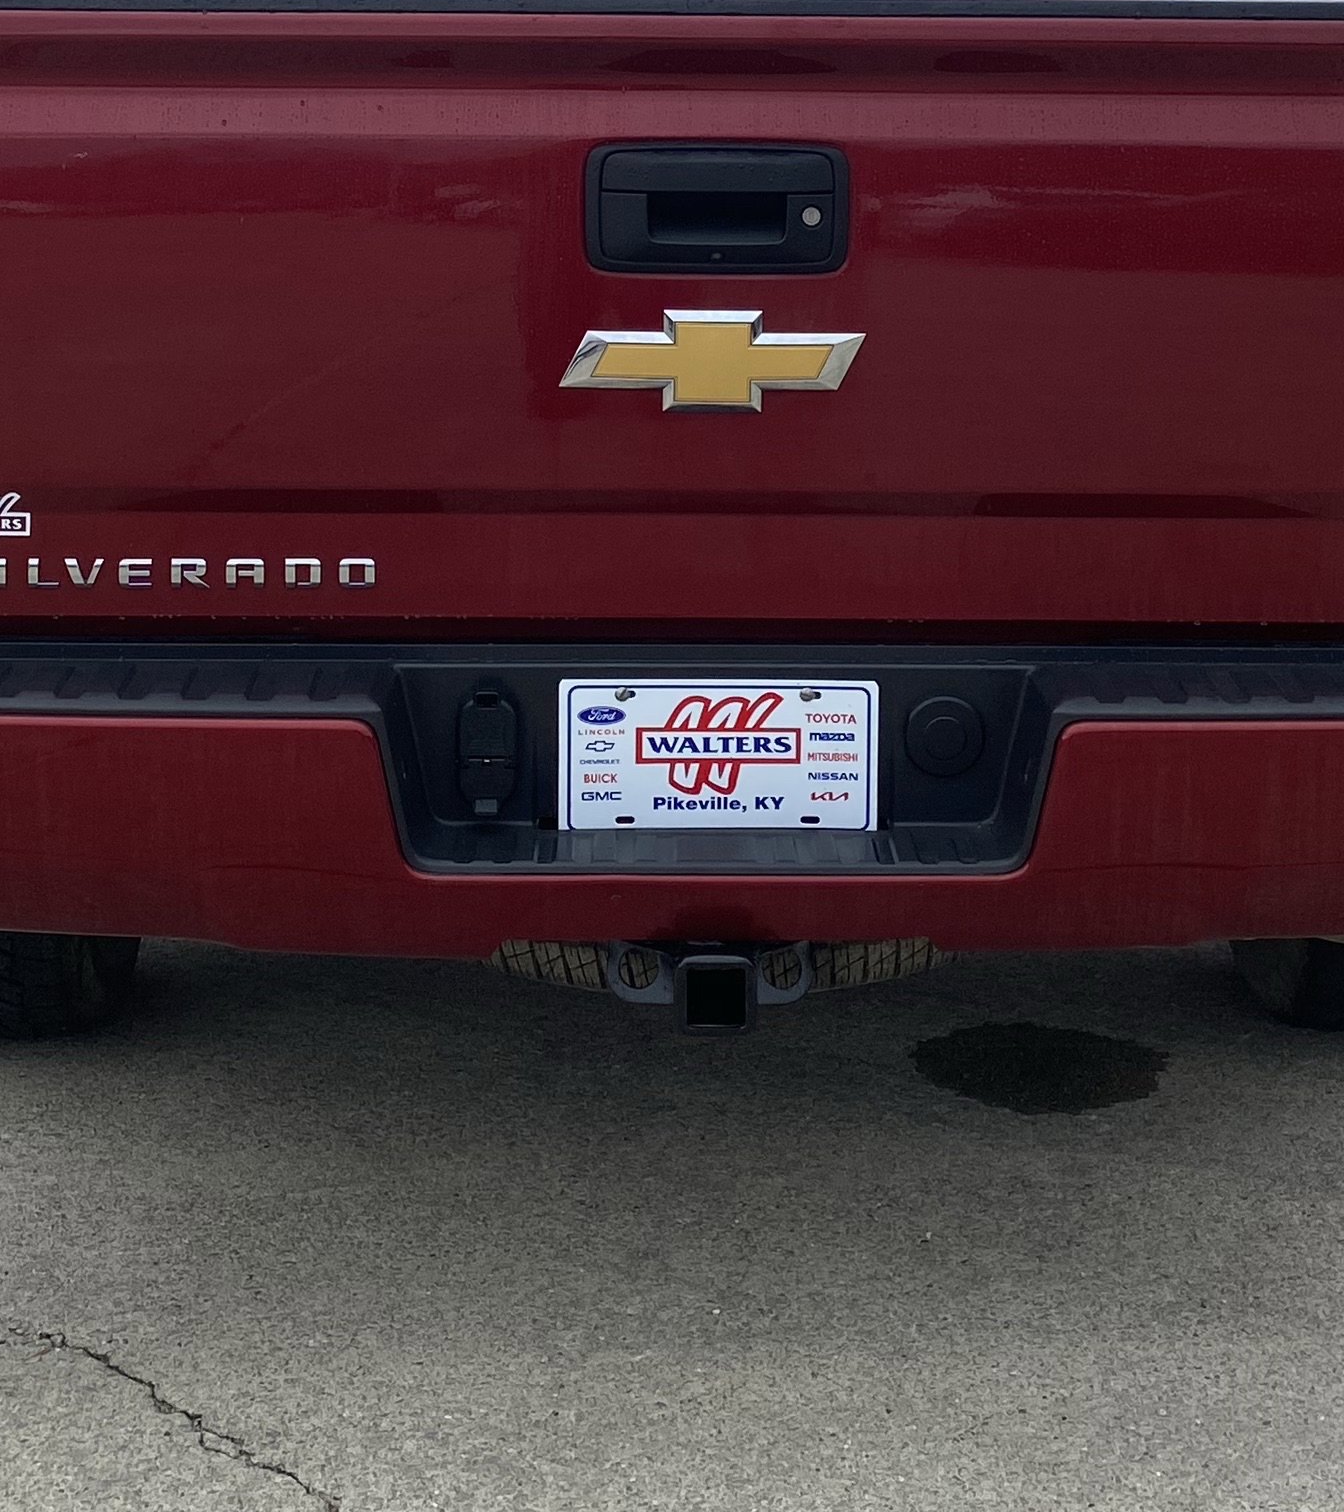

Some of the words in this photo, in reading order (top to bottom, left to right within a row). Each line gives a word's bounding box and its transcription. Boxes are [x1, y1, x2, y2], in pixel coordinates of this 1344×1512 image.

[805, 713, 857, 724] TOYOTA
[646, 736, 792, 754] WALTERS
[807, 752, 858, 762] MITSUBISHI
[584, 773, 618, 784] BUICK
[808, 772, 858, 781] NISSAN
[581, 791, 622, 801] GMC
[653, 796, 747, 812] Pikeville,
[755, 796, 785, 810] KY
